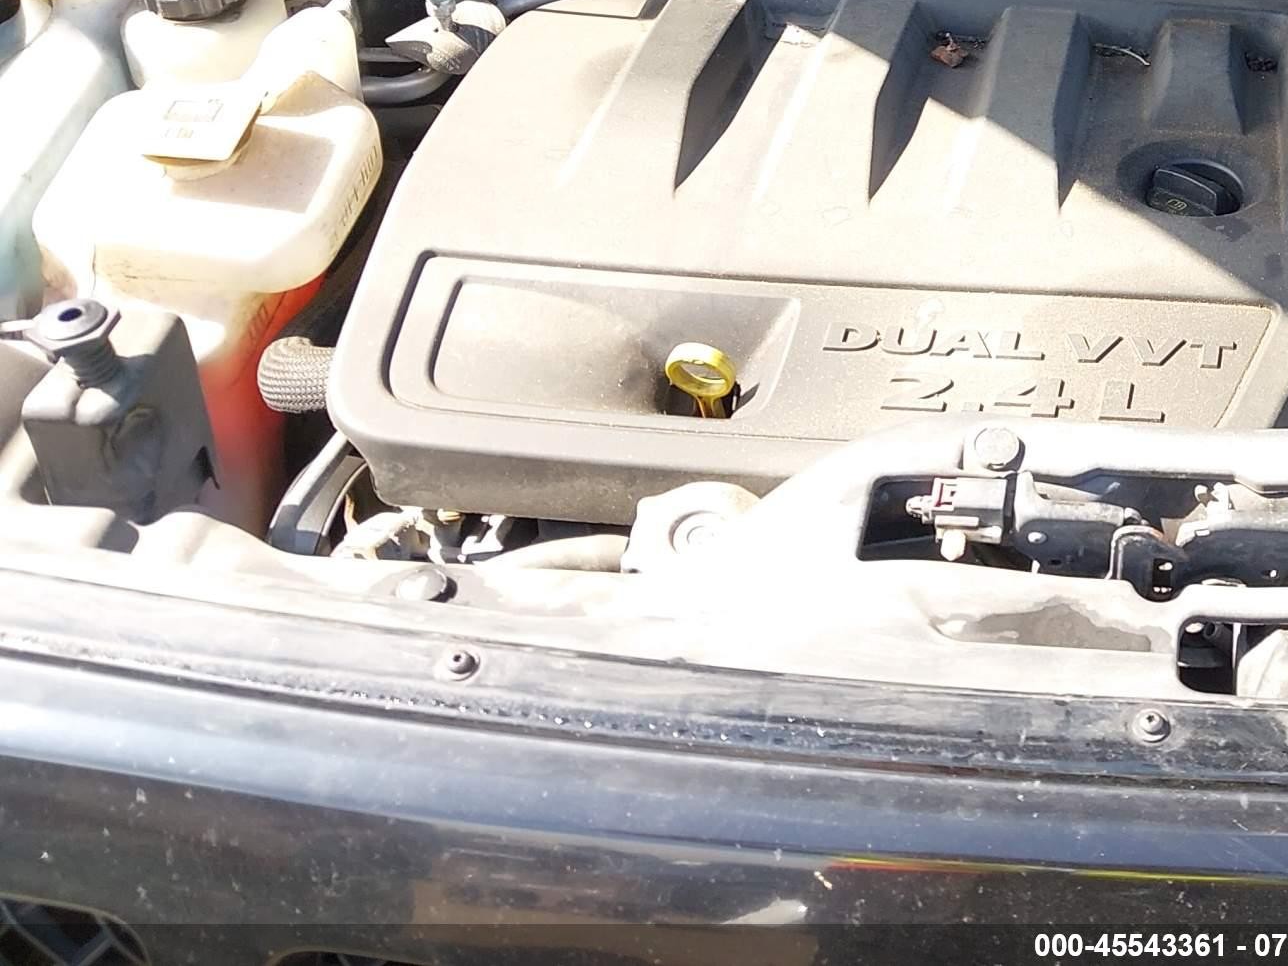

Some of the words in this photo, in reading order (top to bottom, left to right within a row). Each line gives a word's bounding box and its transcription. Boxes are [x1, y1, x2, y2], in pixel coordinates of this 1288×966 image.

[822, 321, 1046, 361] DUAL
[1065, 332, 1238, 369] VVT
[880, 374, 1166, 423] 2.4L
